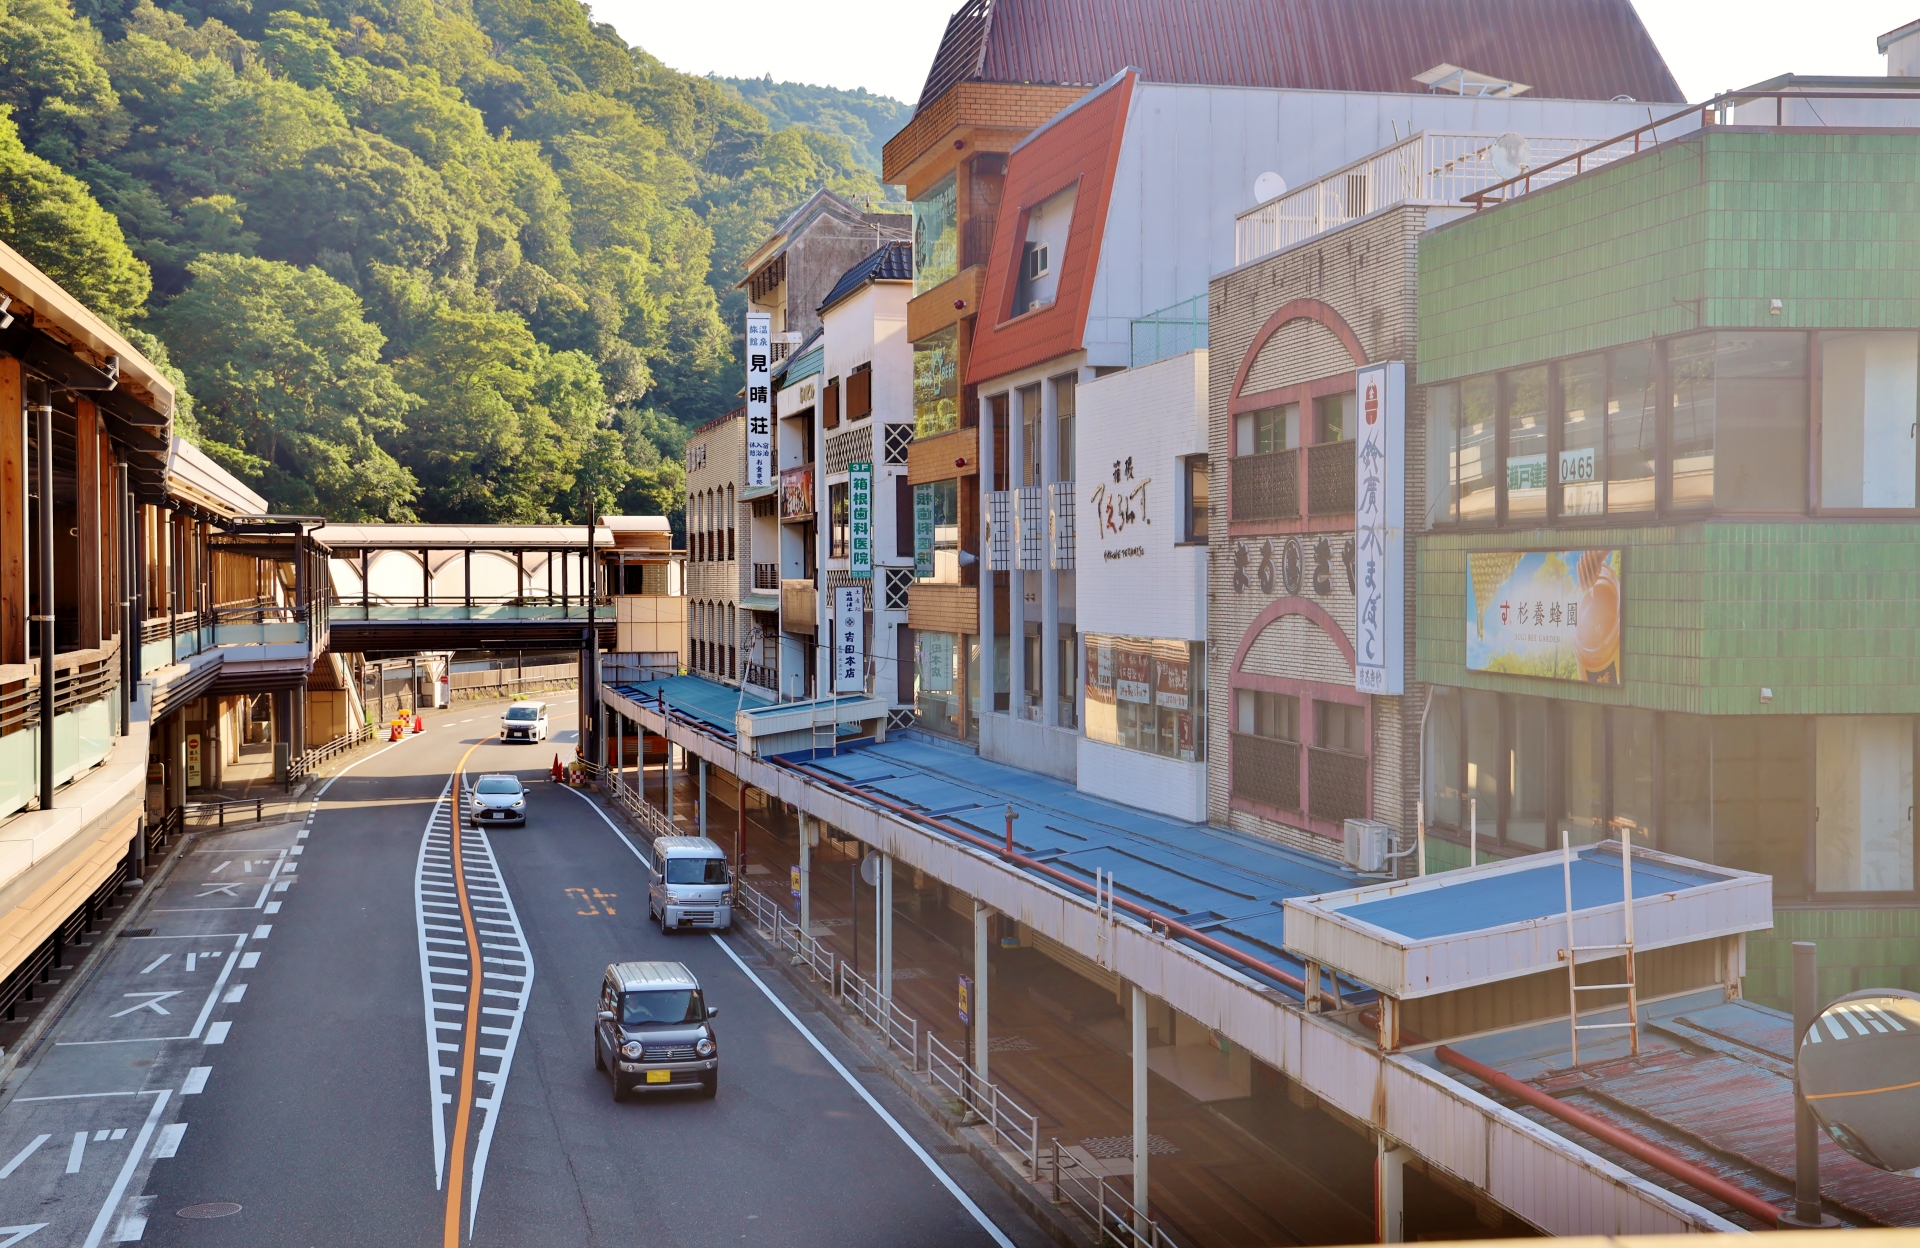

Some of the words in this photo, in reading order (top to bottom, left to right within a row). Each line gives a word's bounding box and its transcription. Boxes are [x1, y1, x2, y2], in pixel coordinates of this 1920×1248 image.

[942, 363, 955, 380] BEEF
[750, 354, 769, 434] 見晴荘
[1561, 455, 1593, 480] 0465
[853, 477, 869, 565] 箱根歯科医院
[1517, 601, 1578, 628] 杉養蜂園
[1515, 633, 1527, 641] SUGI
[1528, 634, 1537, 642] BEE
[1538, 634, 1560, 643] GARDEN
[1099, 674, 1110, 684] TAX
[564, 887, 617, 915] 40
